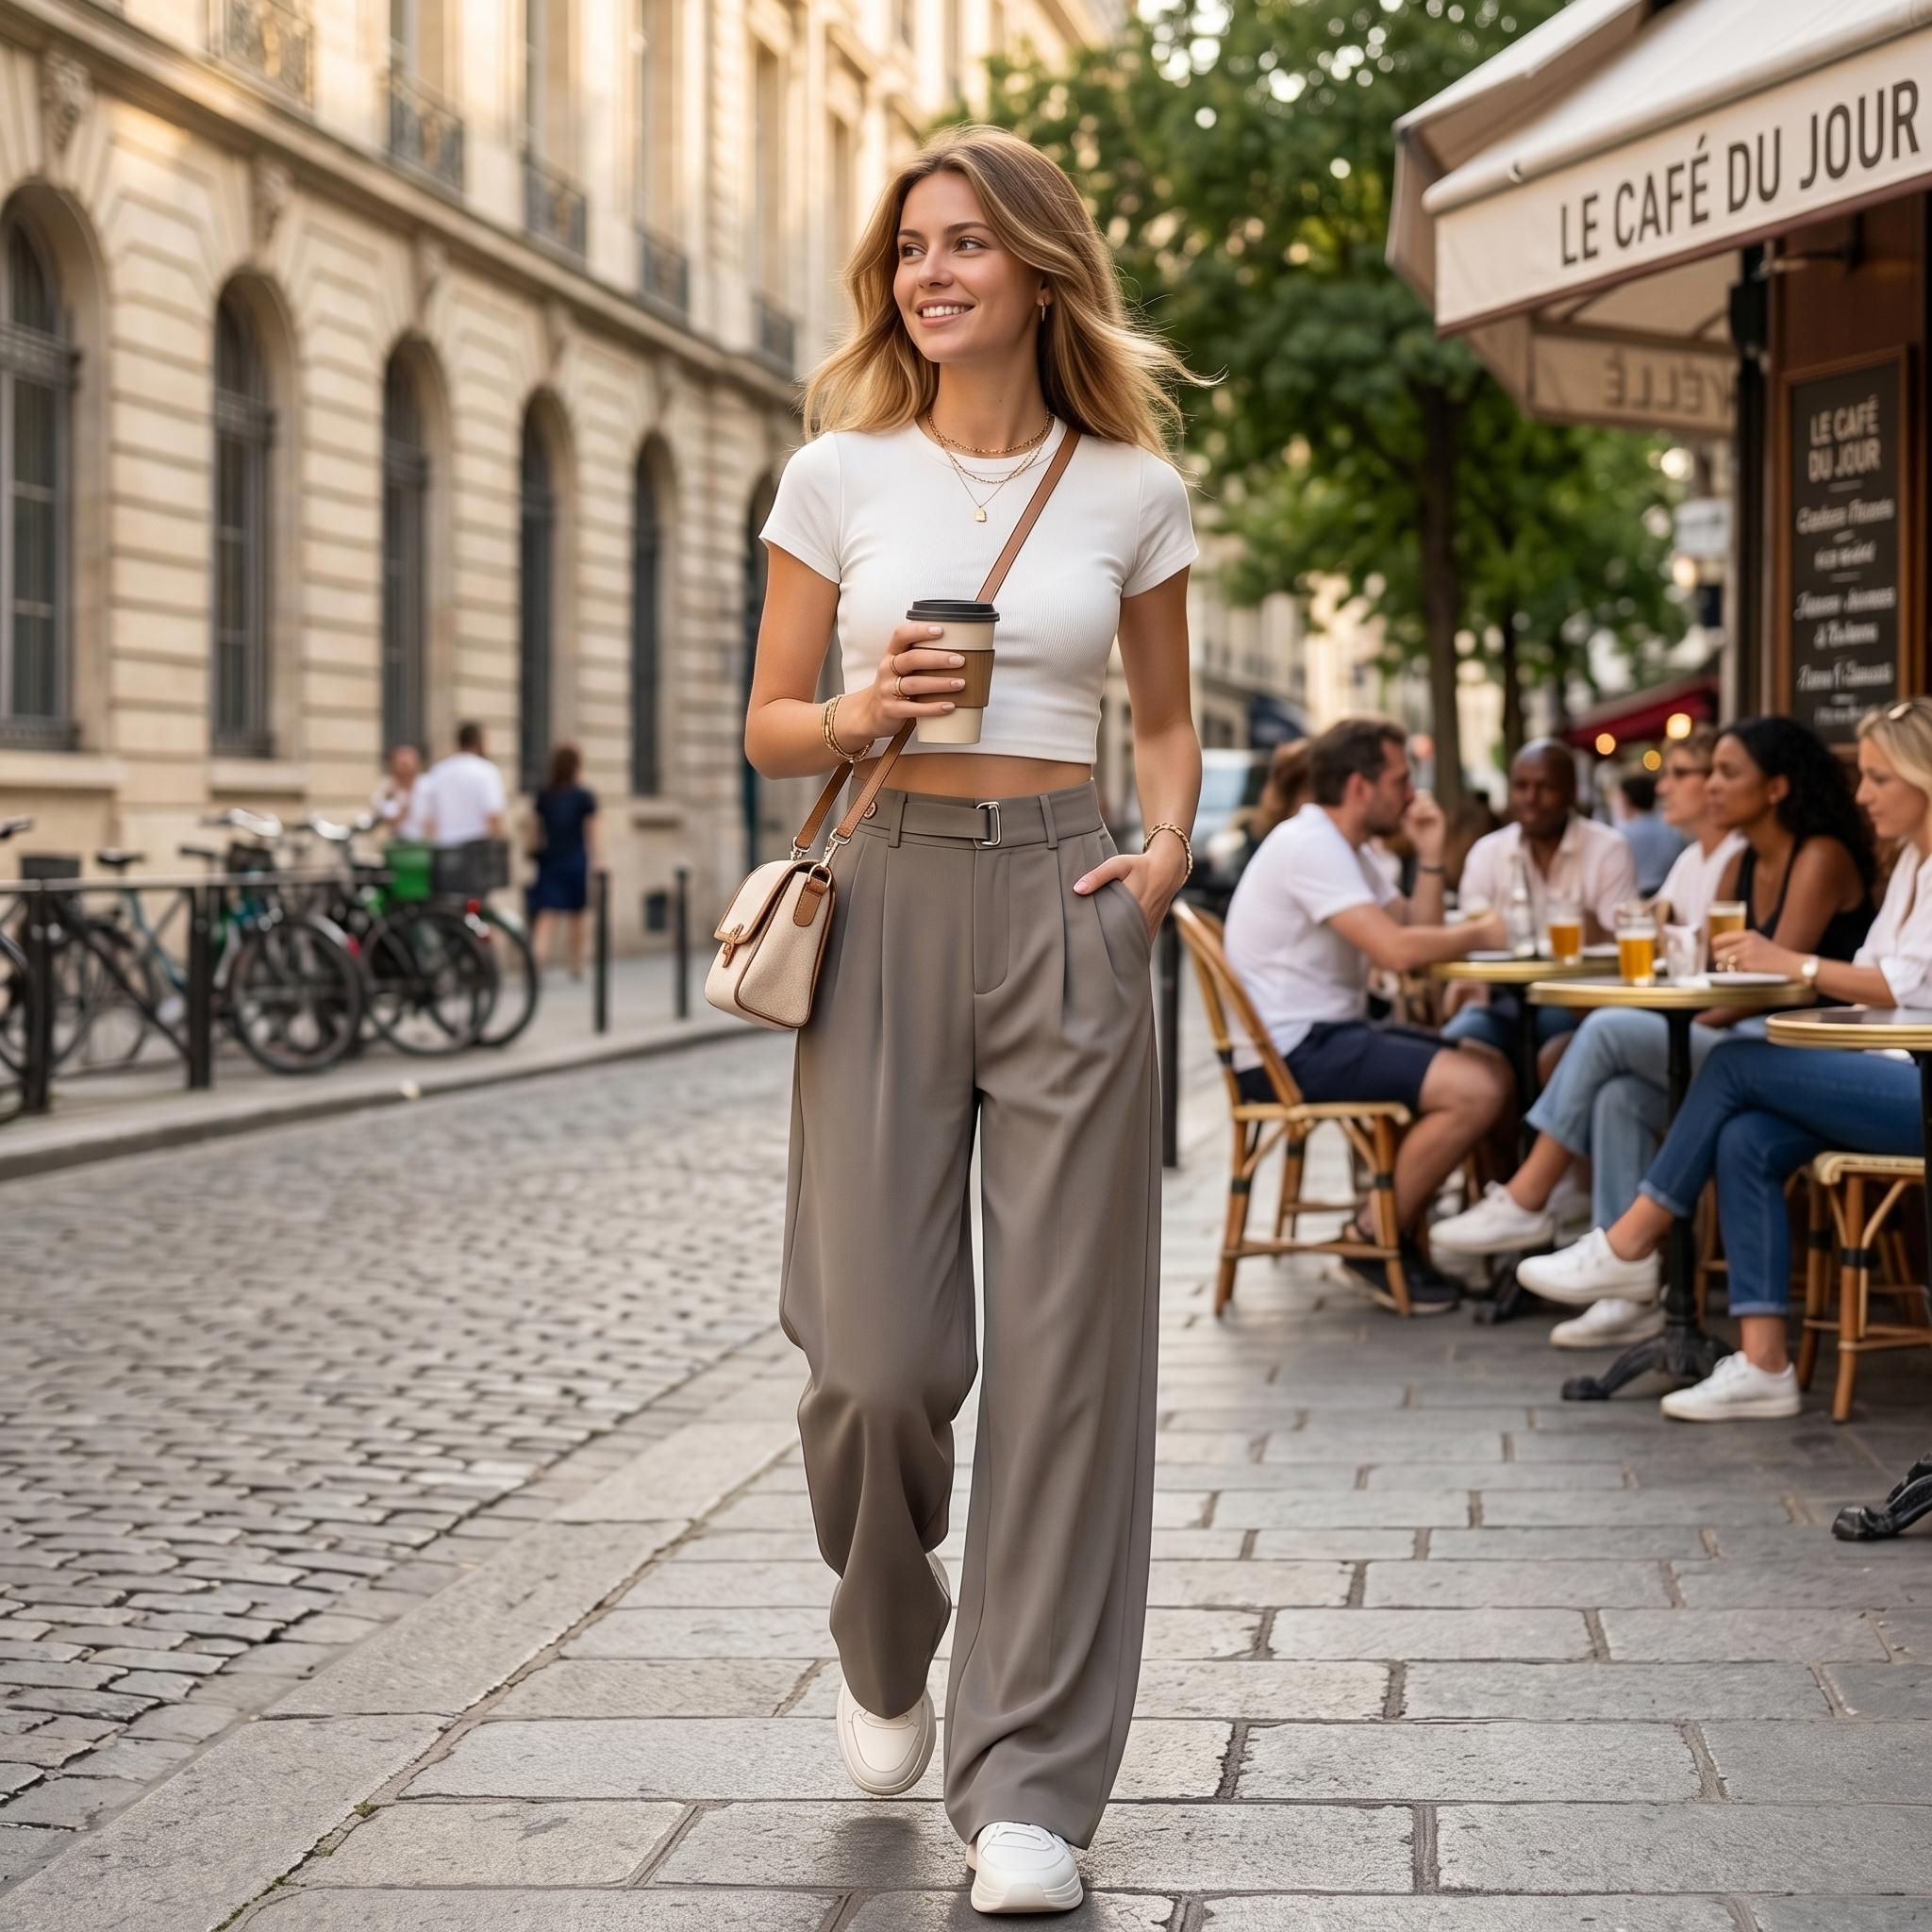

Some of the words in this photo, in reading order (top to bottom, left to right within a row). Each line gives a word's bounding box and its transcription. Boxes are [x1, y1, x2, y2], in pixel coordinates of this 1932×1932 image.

[1561, 192, 1598, 266] LE
[1615, 133, 1709, 249] CAFÉ
[1728, 127, 1780, 213] DU
[1800, 79, 1920, 191] JOUR
[1810, 410, 1832, 447] LE
[1833, 394, 1879, 441] CAFÉ
[1808, 446, 1833, 482] DU
[1834, 437, 1881, 477] JOUR
